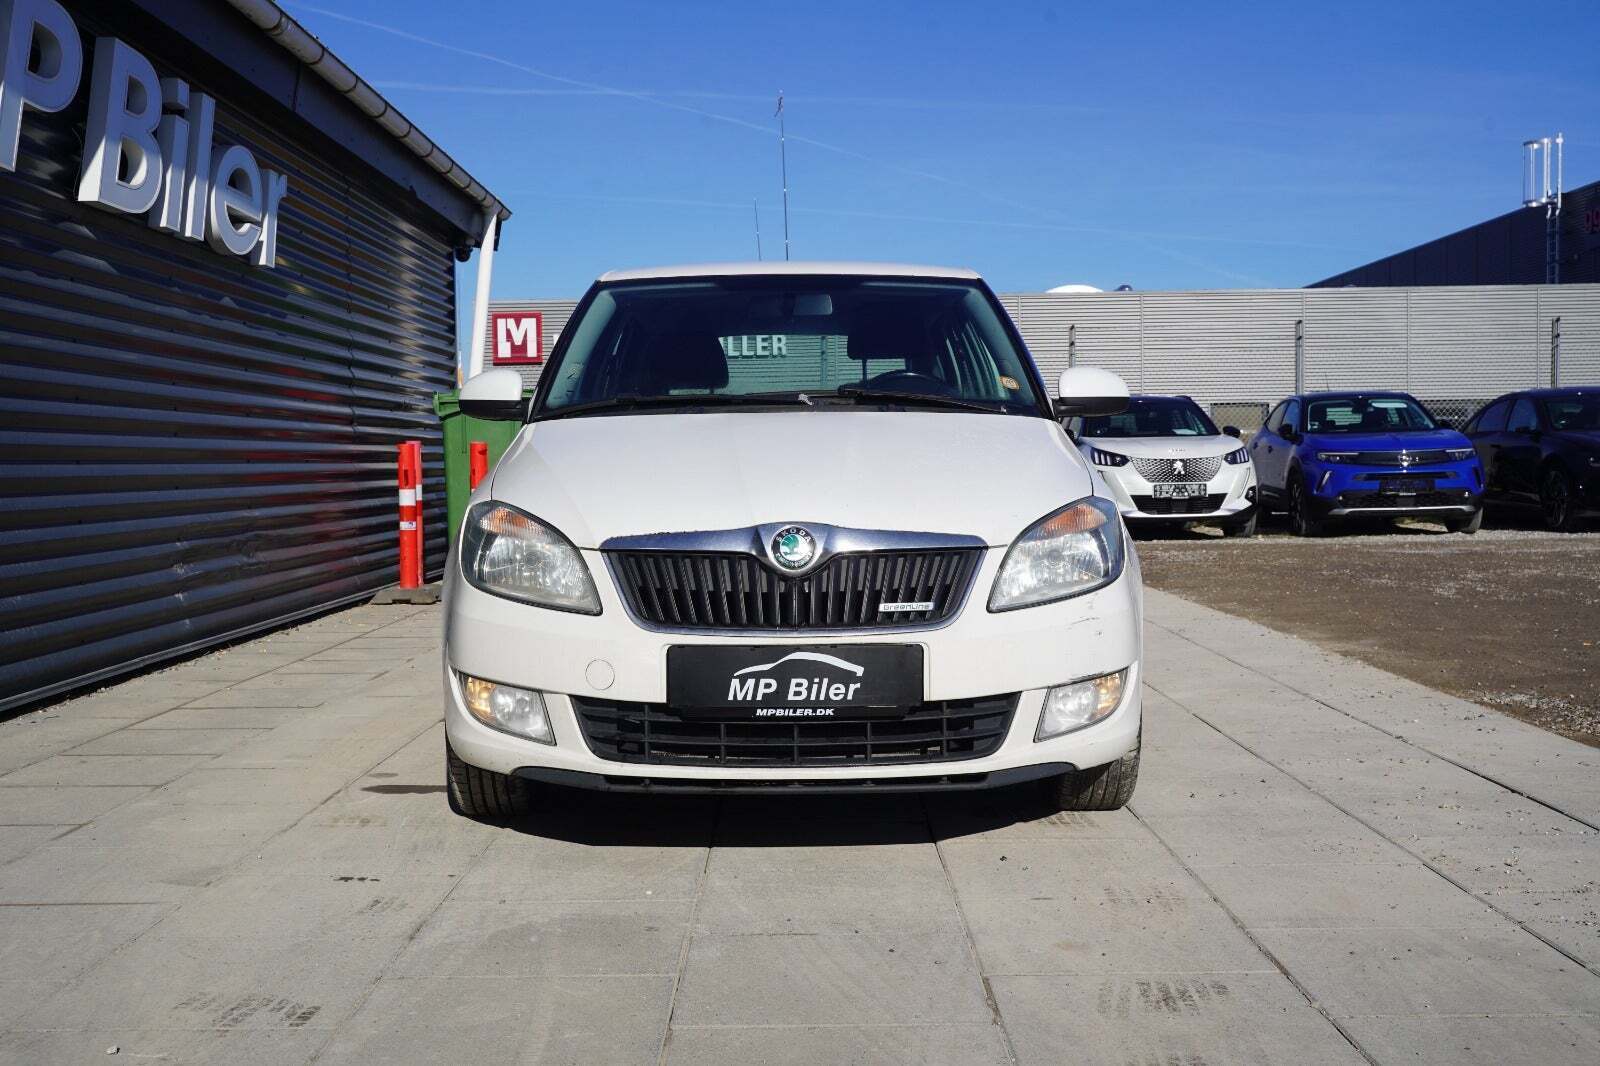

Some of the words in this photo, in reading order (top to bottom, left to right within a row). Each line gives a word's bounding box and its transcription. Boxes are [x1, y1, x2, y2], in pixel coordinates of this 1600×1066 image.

[79, 38, 287, 269] Biler
[718, 334, 787, 356] LLER
[728, 678, 778, 701] MP
[787, 677, 862, 701] Biler
[756, 708, 835, 716] MPBILER.DK
